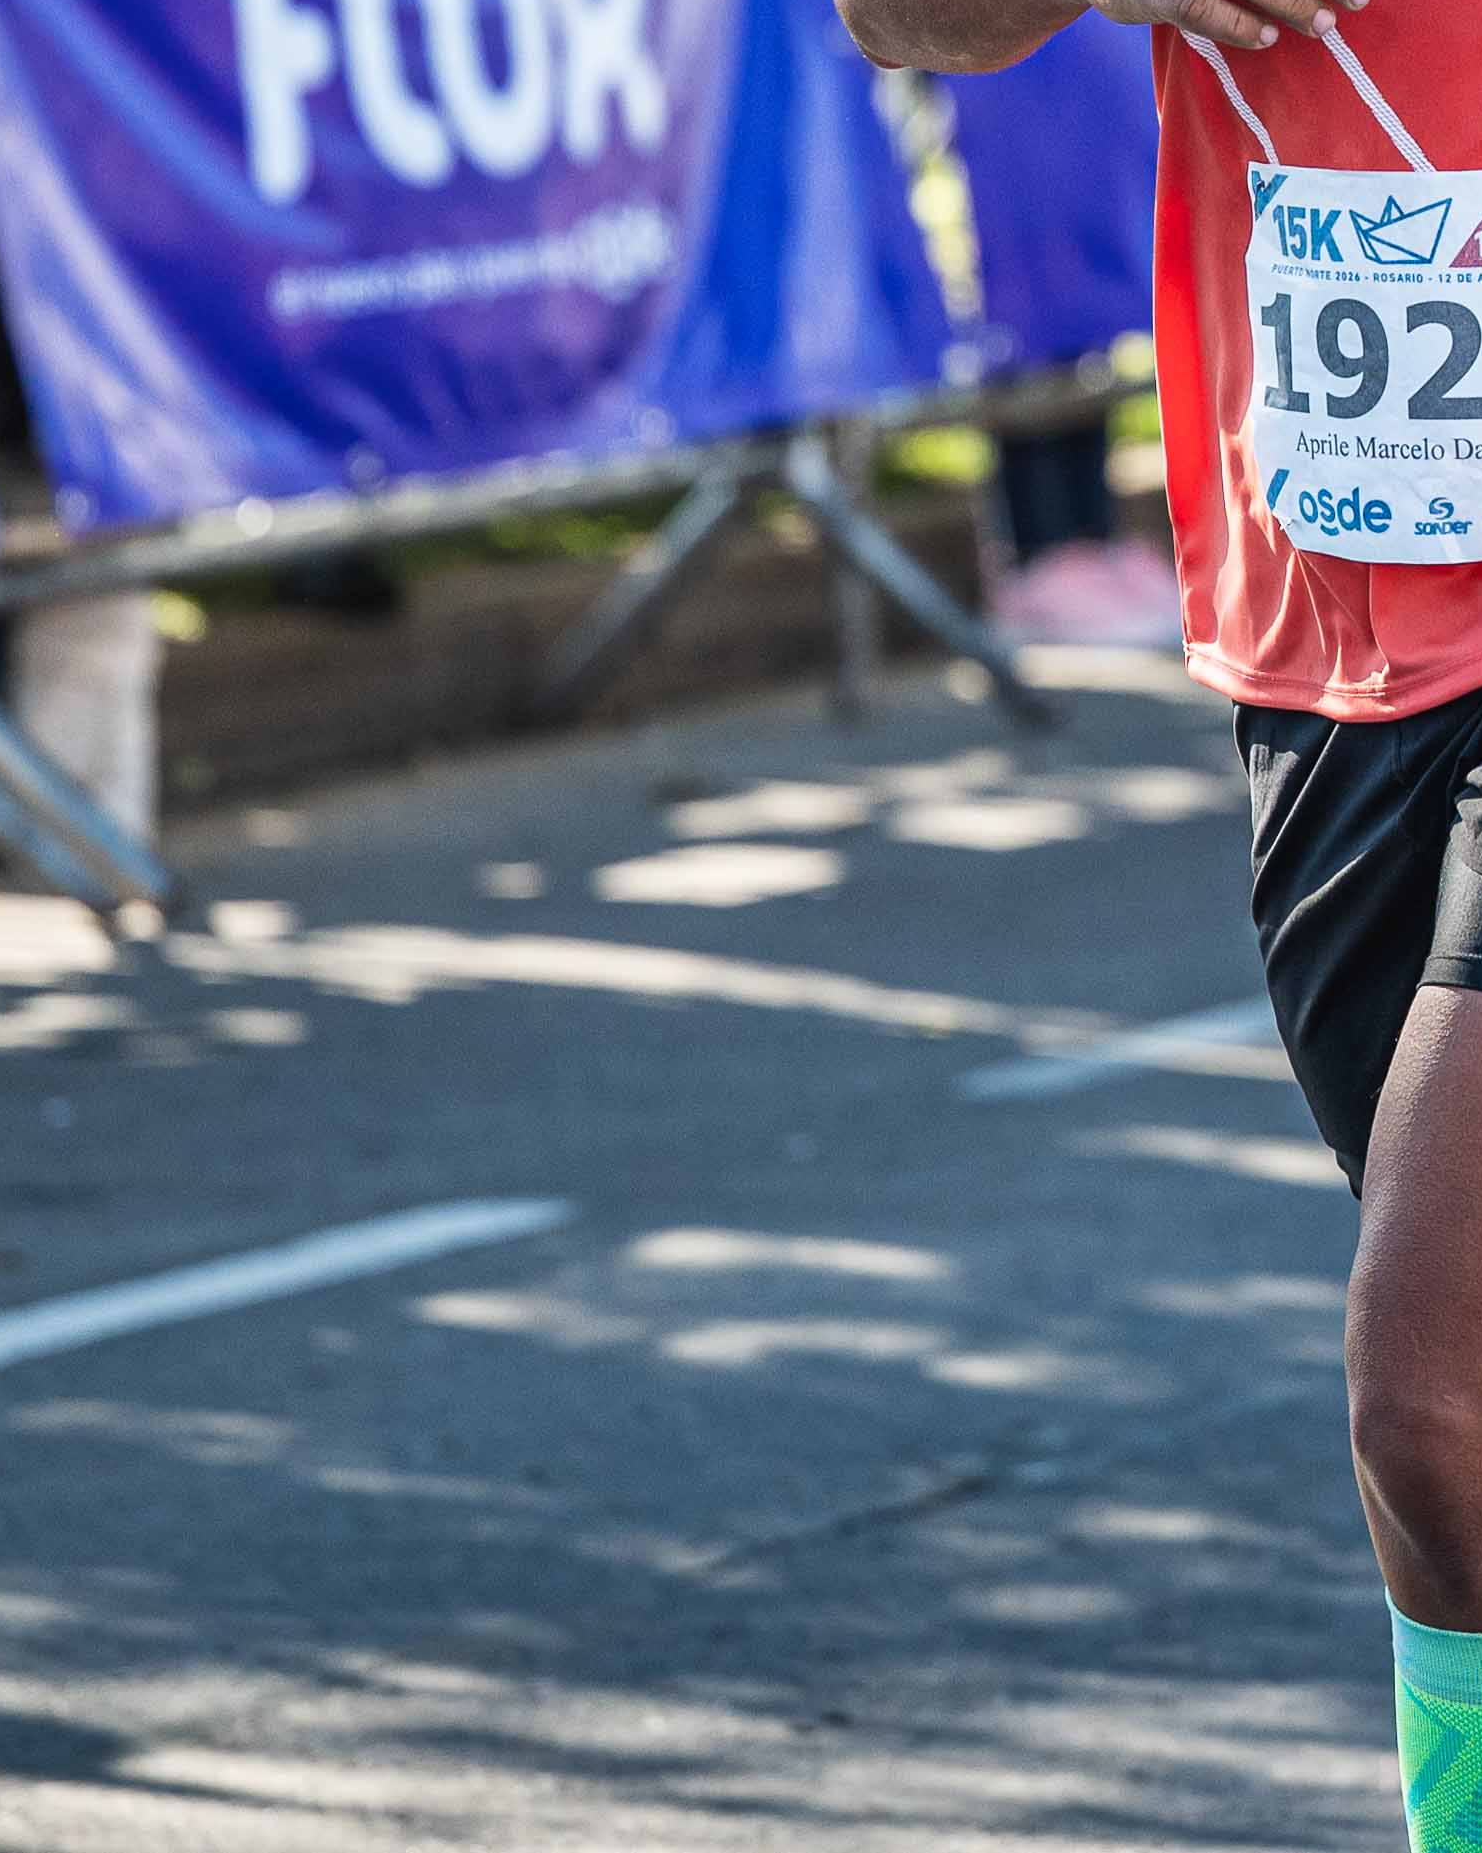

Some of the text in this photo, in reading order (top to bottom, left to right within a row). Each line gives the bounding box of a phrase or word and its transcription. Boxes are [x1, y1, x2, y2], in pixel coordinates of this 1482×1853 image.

[1272, 204, 1345, 263] 15K
[1334, 270, 1362, 283] 2026
[1373, 272, 1424, 284] ROSARIO
[1437, 273, 1453, 284] 12
[1457, 272, 1473, 284] DE
[1296, 430, 1350, 460] Aprile
[1356, 435, 1446, 461] Marcelo
[1299, 486, 1393, 536] osde
